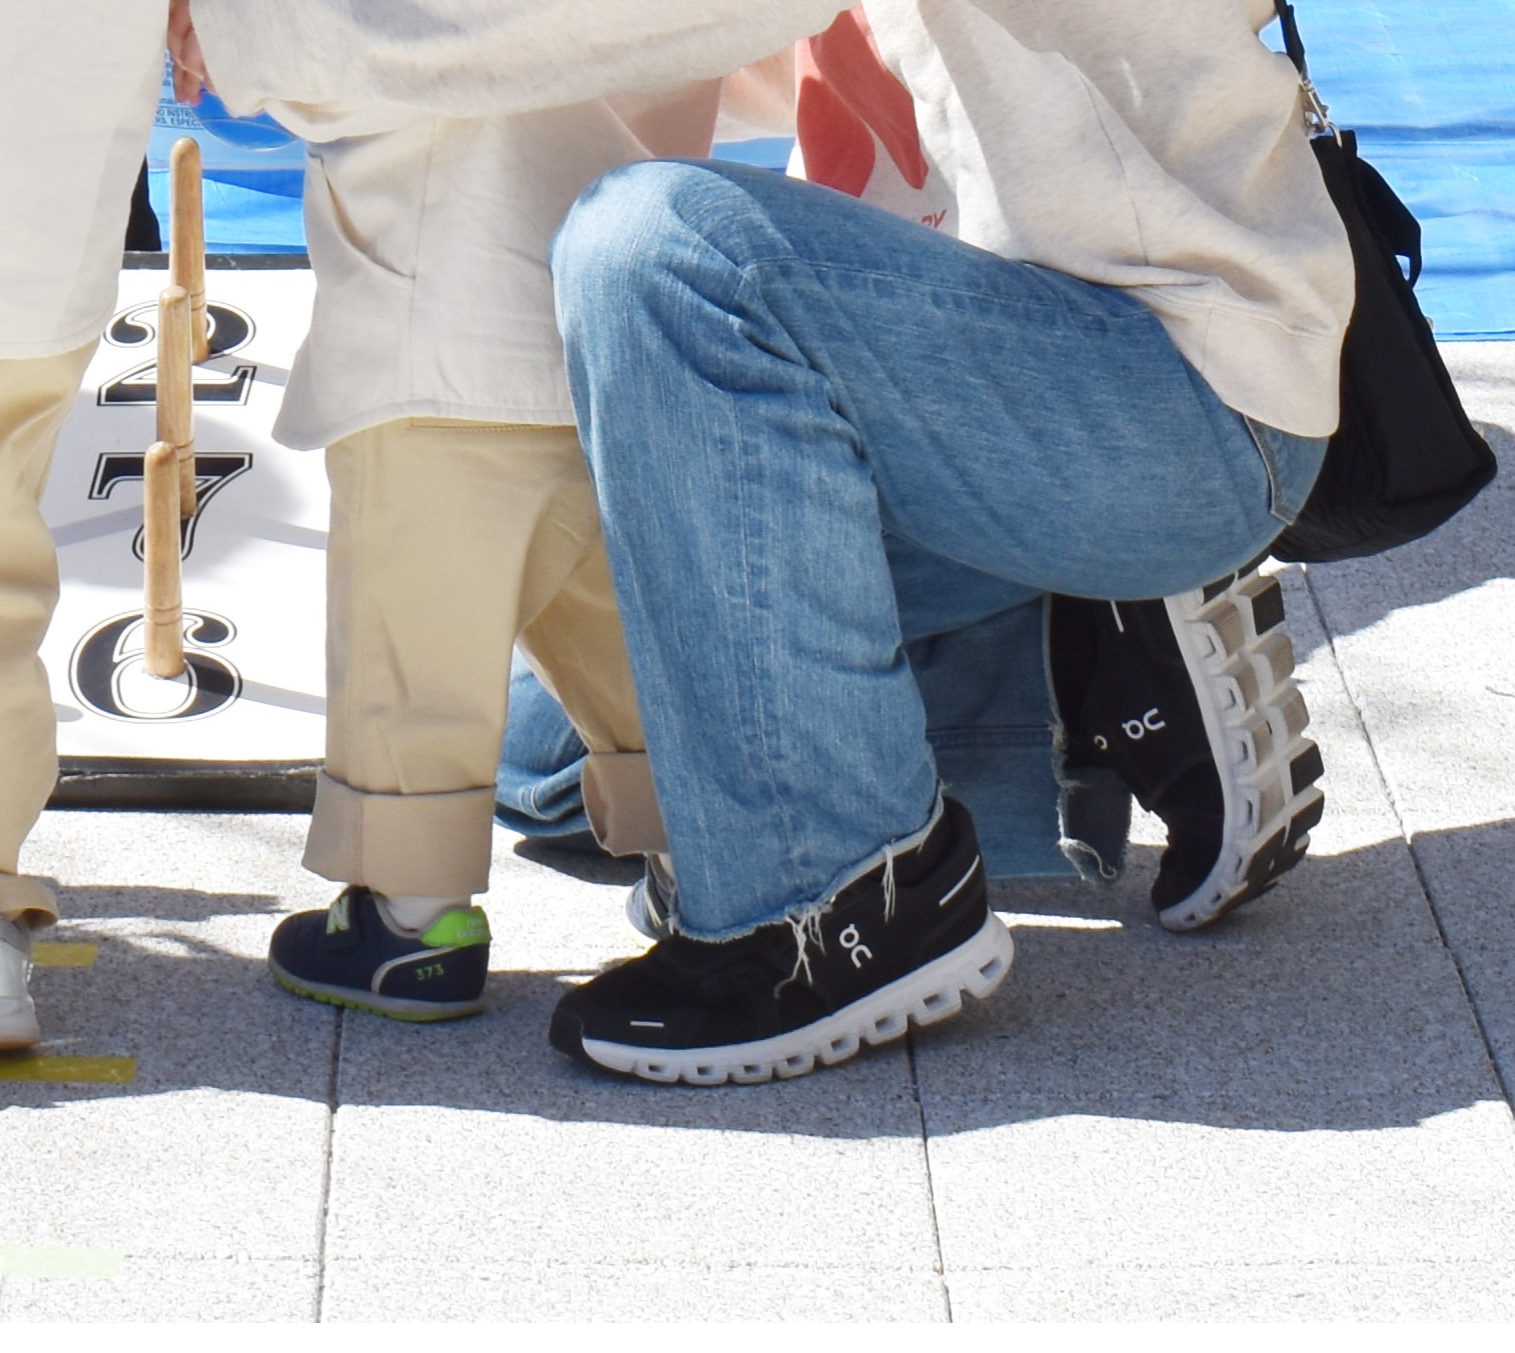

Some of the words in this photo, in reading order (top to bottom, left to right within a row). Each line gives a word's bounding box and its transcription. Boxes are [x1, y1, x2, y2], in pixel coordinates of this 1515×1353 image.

[97, 300, 257, 406] 2
[90, 452, 253, 560] 7
[71, 610, 241, 722] 6
[326, 895, 351, 935] N
[415, 963, 445, 981] 373
